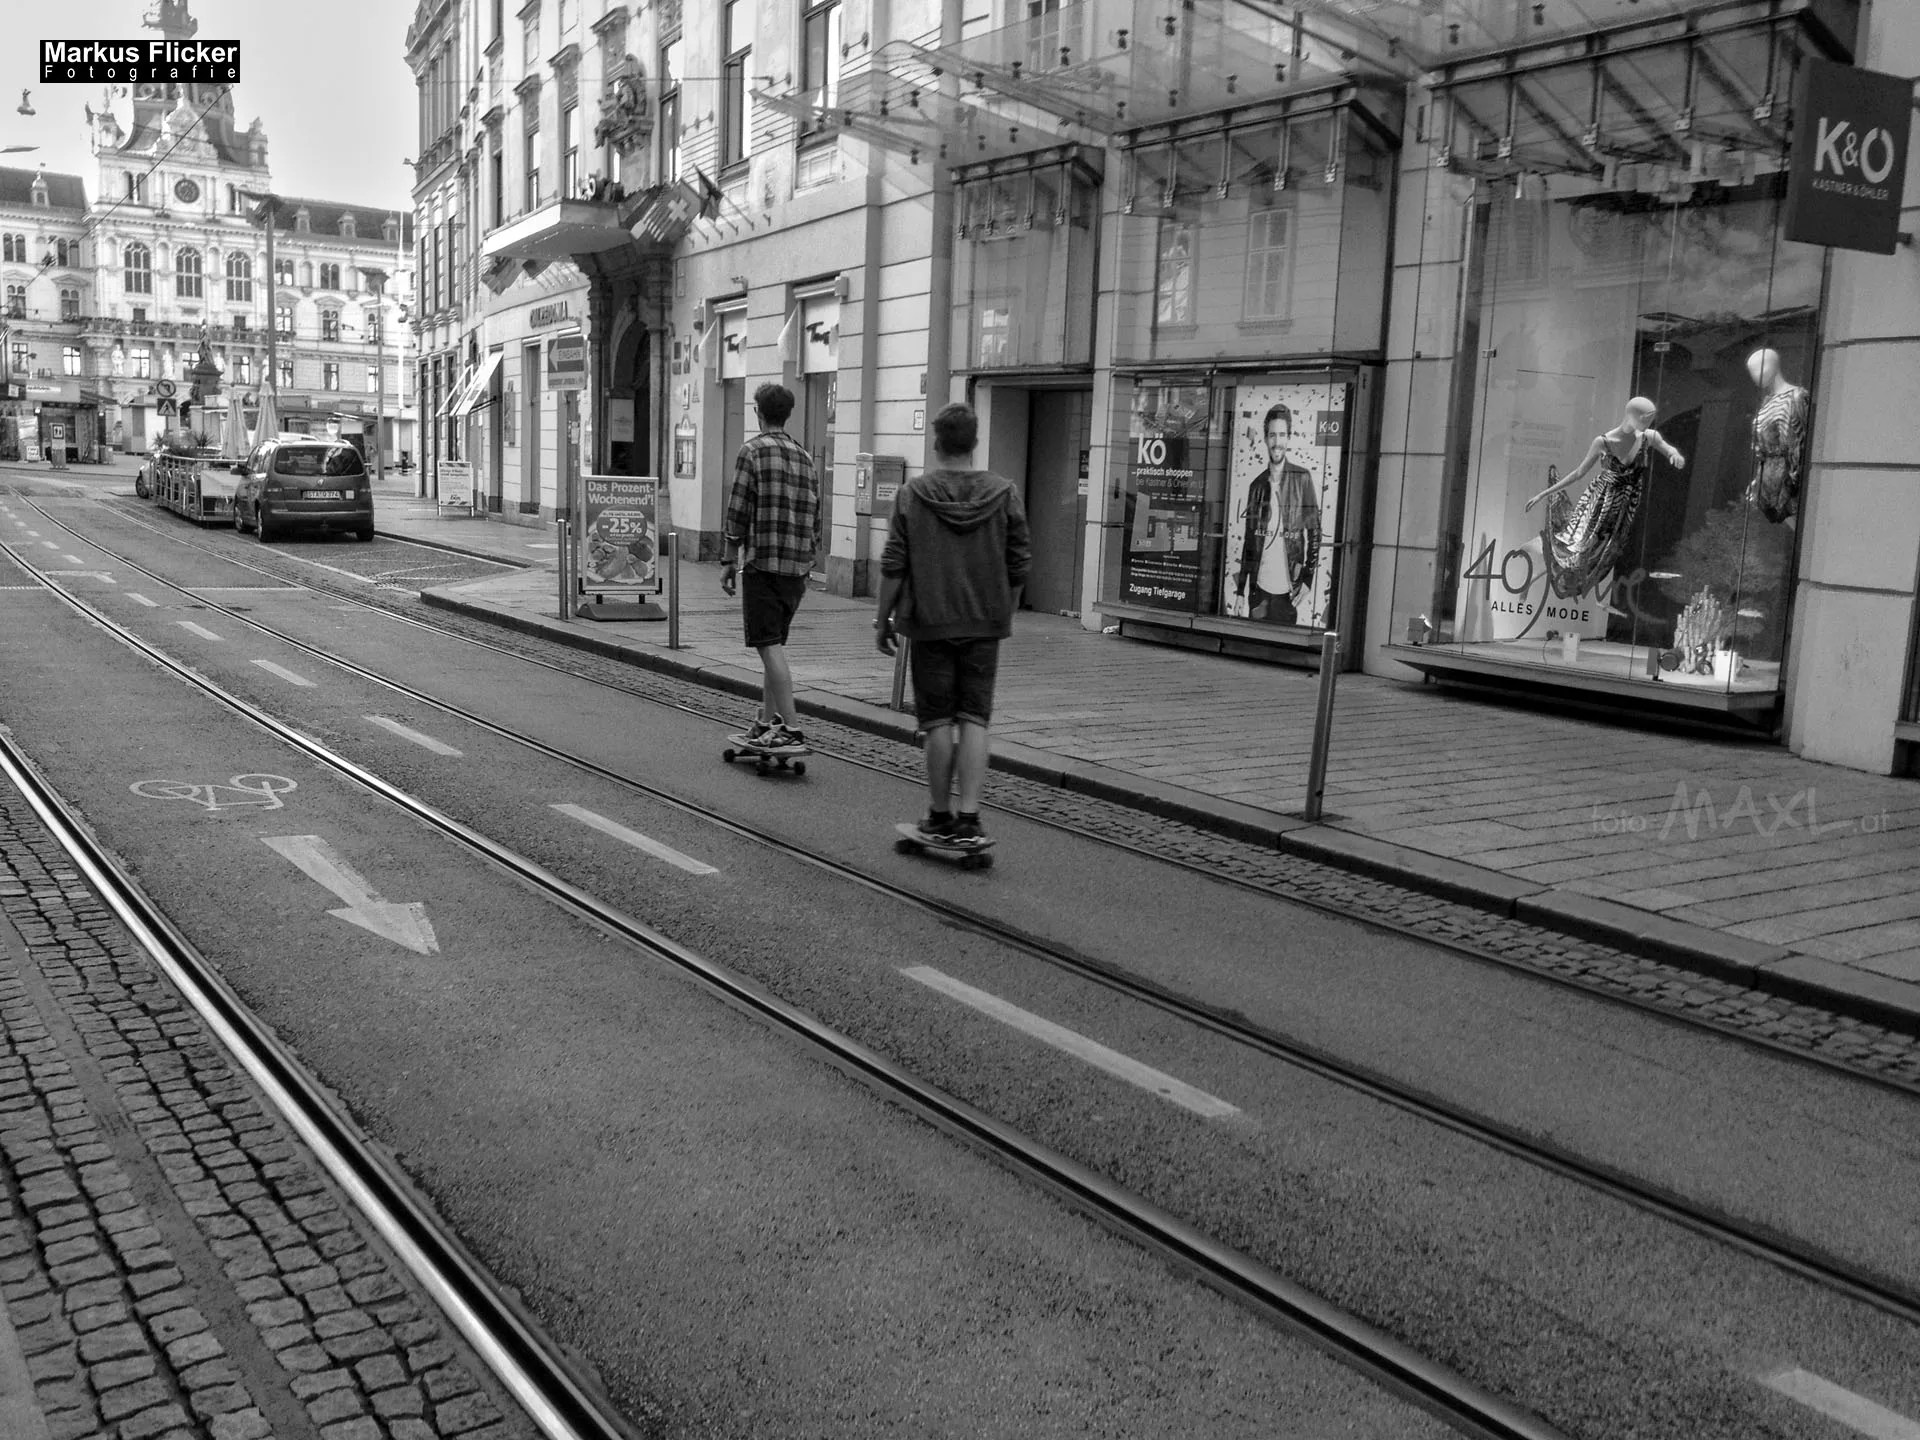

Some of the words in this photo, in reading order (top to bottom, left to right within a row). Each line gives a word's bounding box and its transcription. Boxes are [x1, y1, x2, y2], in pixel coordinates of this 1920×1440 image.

[1165, 467, 1194, 479] shoppen
[588, 481, 608, 493] Das
[611, 482, 654, 494] Prozent-
[601, 517, 643, 534] -25%
[1129, 583, 1153, 597] Zugang
[1153, 586, 1187, 601] Tiefgarage
[1491, 600, 1534, 616] ALLES
[1546, 606, 1590, 622] MODE
